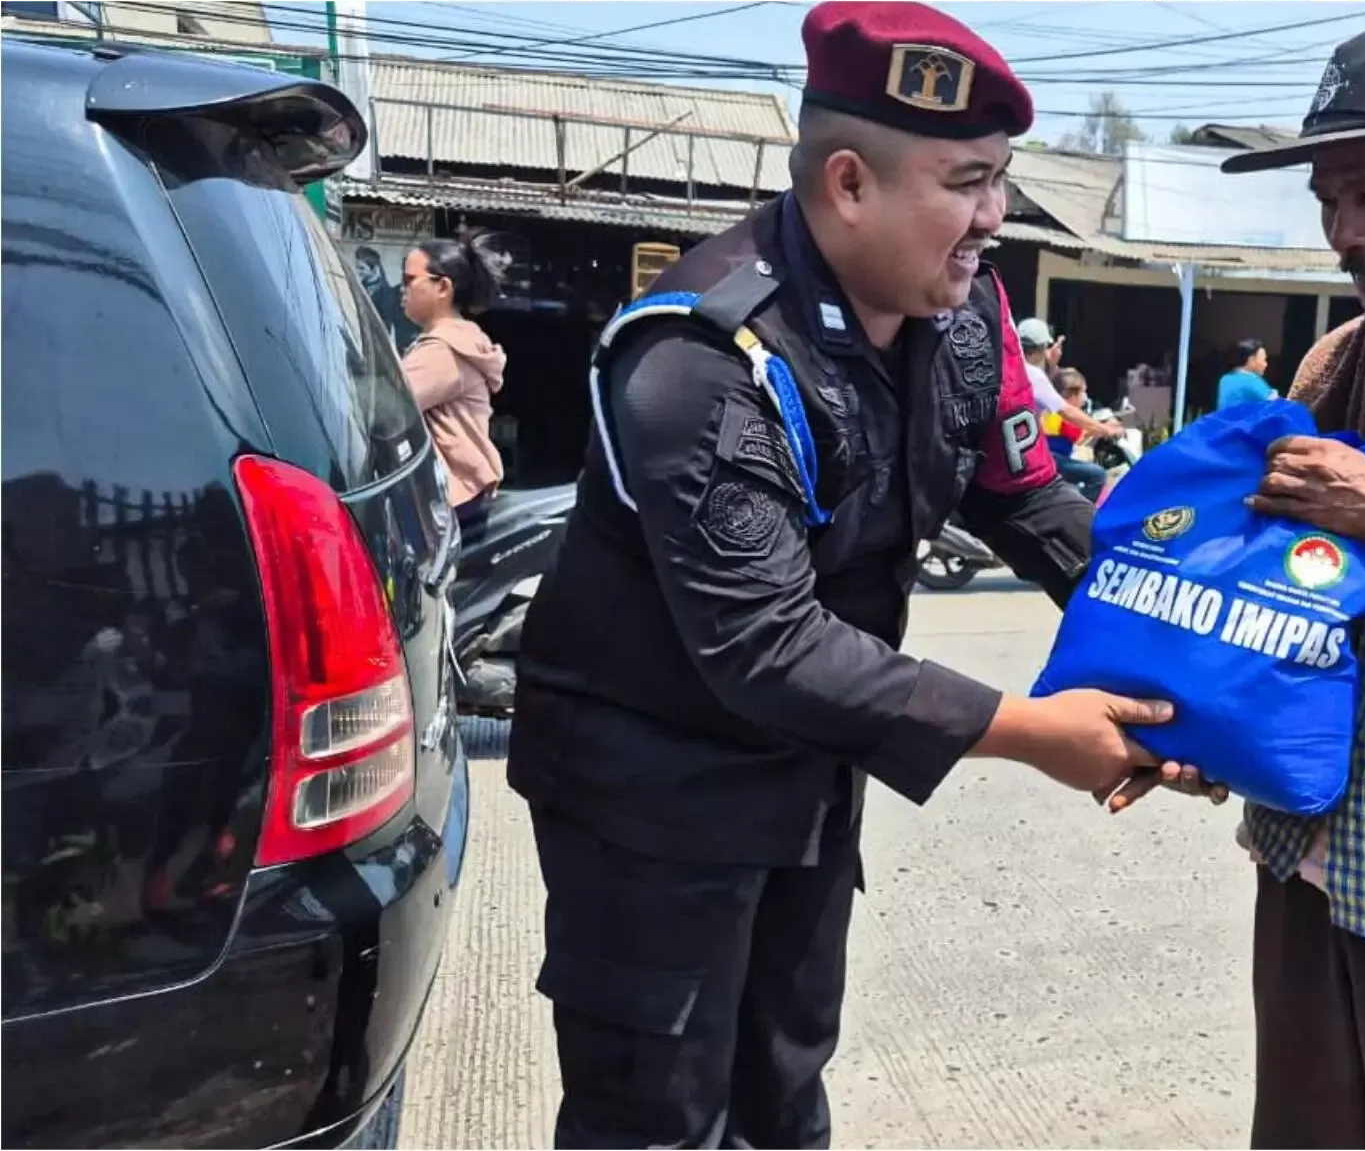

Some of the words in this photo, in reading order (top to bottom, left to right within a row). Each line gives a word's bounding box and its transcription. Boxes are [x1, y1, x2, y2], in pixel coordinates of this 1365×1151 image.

[1003, 410, 1039, 473] P
[1088, 558, 1223, 636] SEMBAKO
[1219, 599, 1346, 669] IMIPAS
